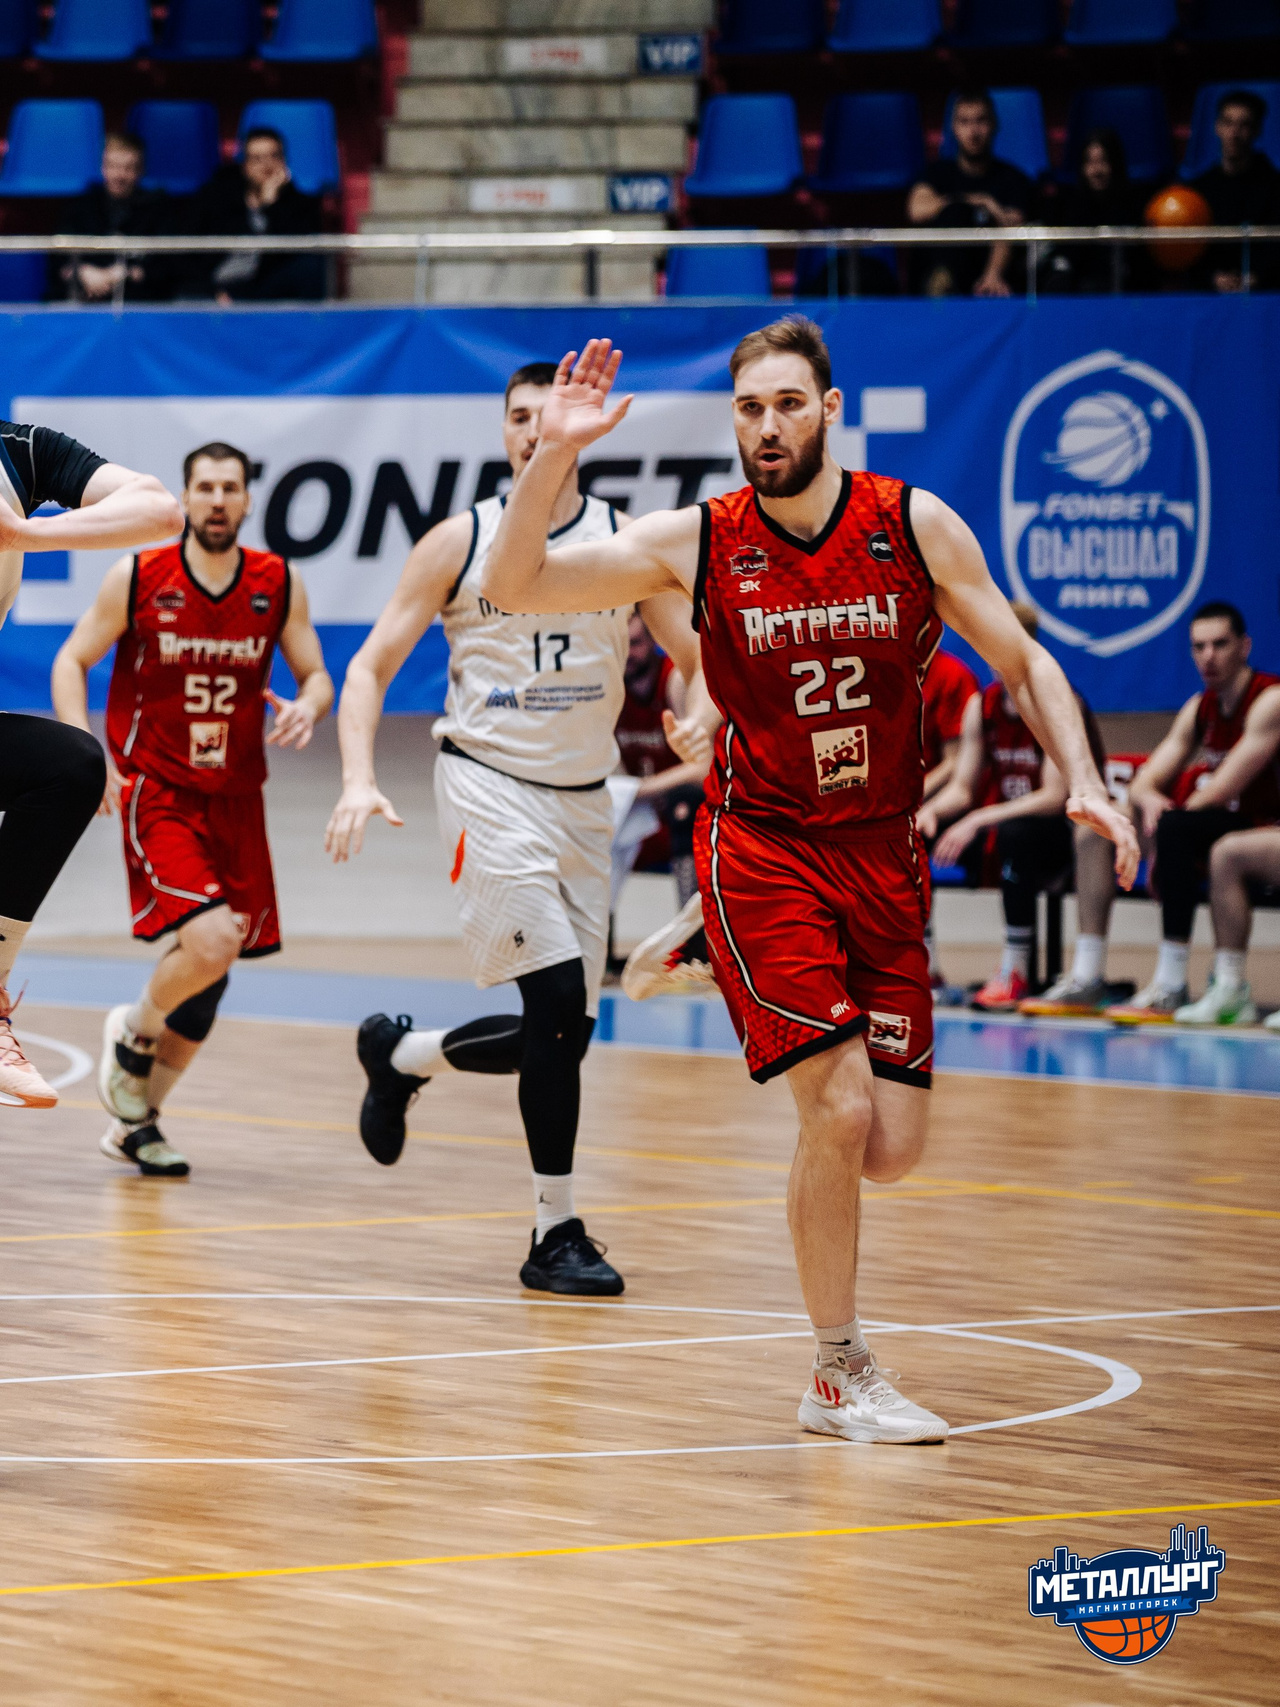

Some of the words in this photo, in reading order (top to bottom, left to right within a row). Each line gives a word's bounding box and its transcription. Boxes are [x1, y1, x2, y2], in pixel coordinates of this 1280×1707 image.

[645, 41, 696, 68] VIP
[614, 177, 668, 209] VIP
[1043, 492, 1163, 521] FONBET
[1028, 526, 1179, 579] ВЫСШАЯ
[1057, 583, 1151, 608] ЛИГА
[737, 594, 900, 656] ЯСТРЕБЫ
[534, 631, 570, 672] 17
[183, 673, 238, 715] 52
[790, 656, 871, 716] 22
